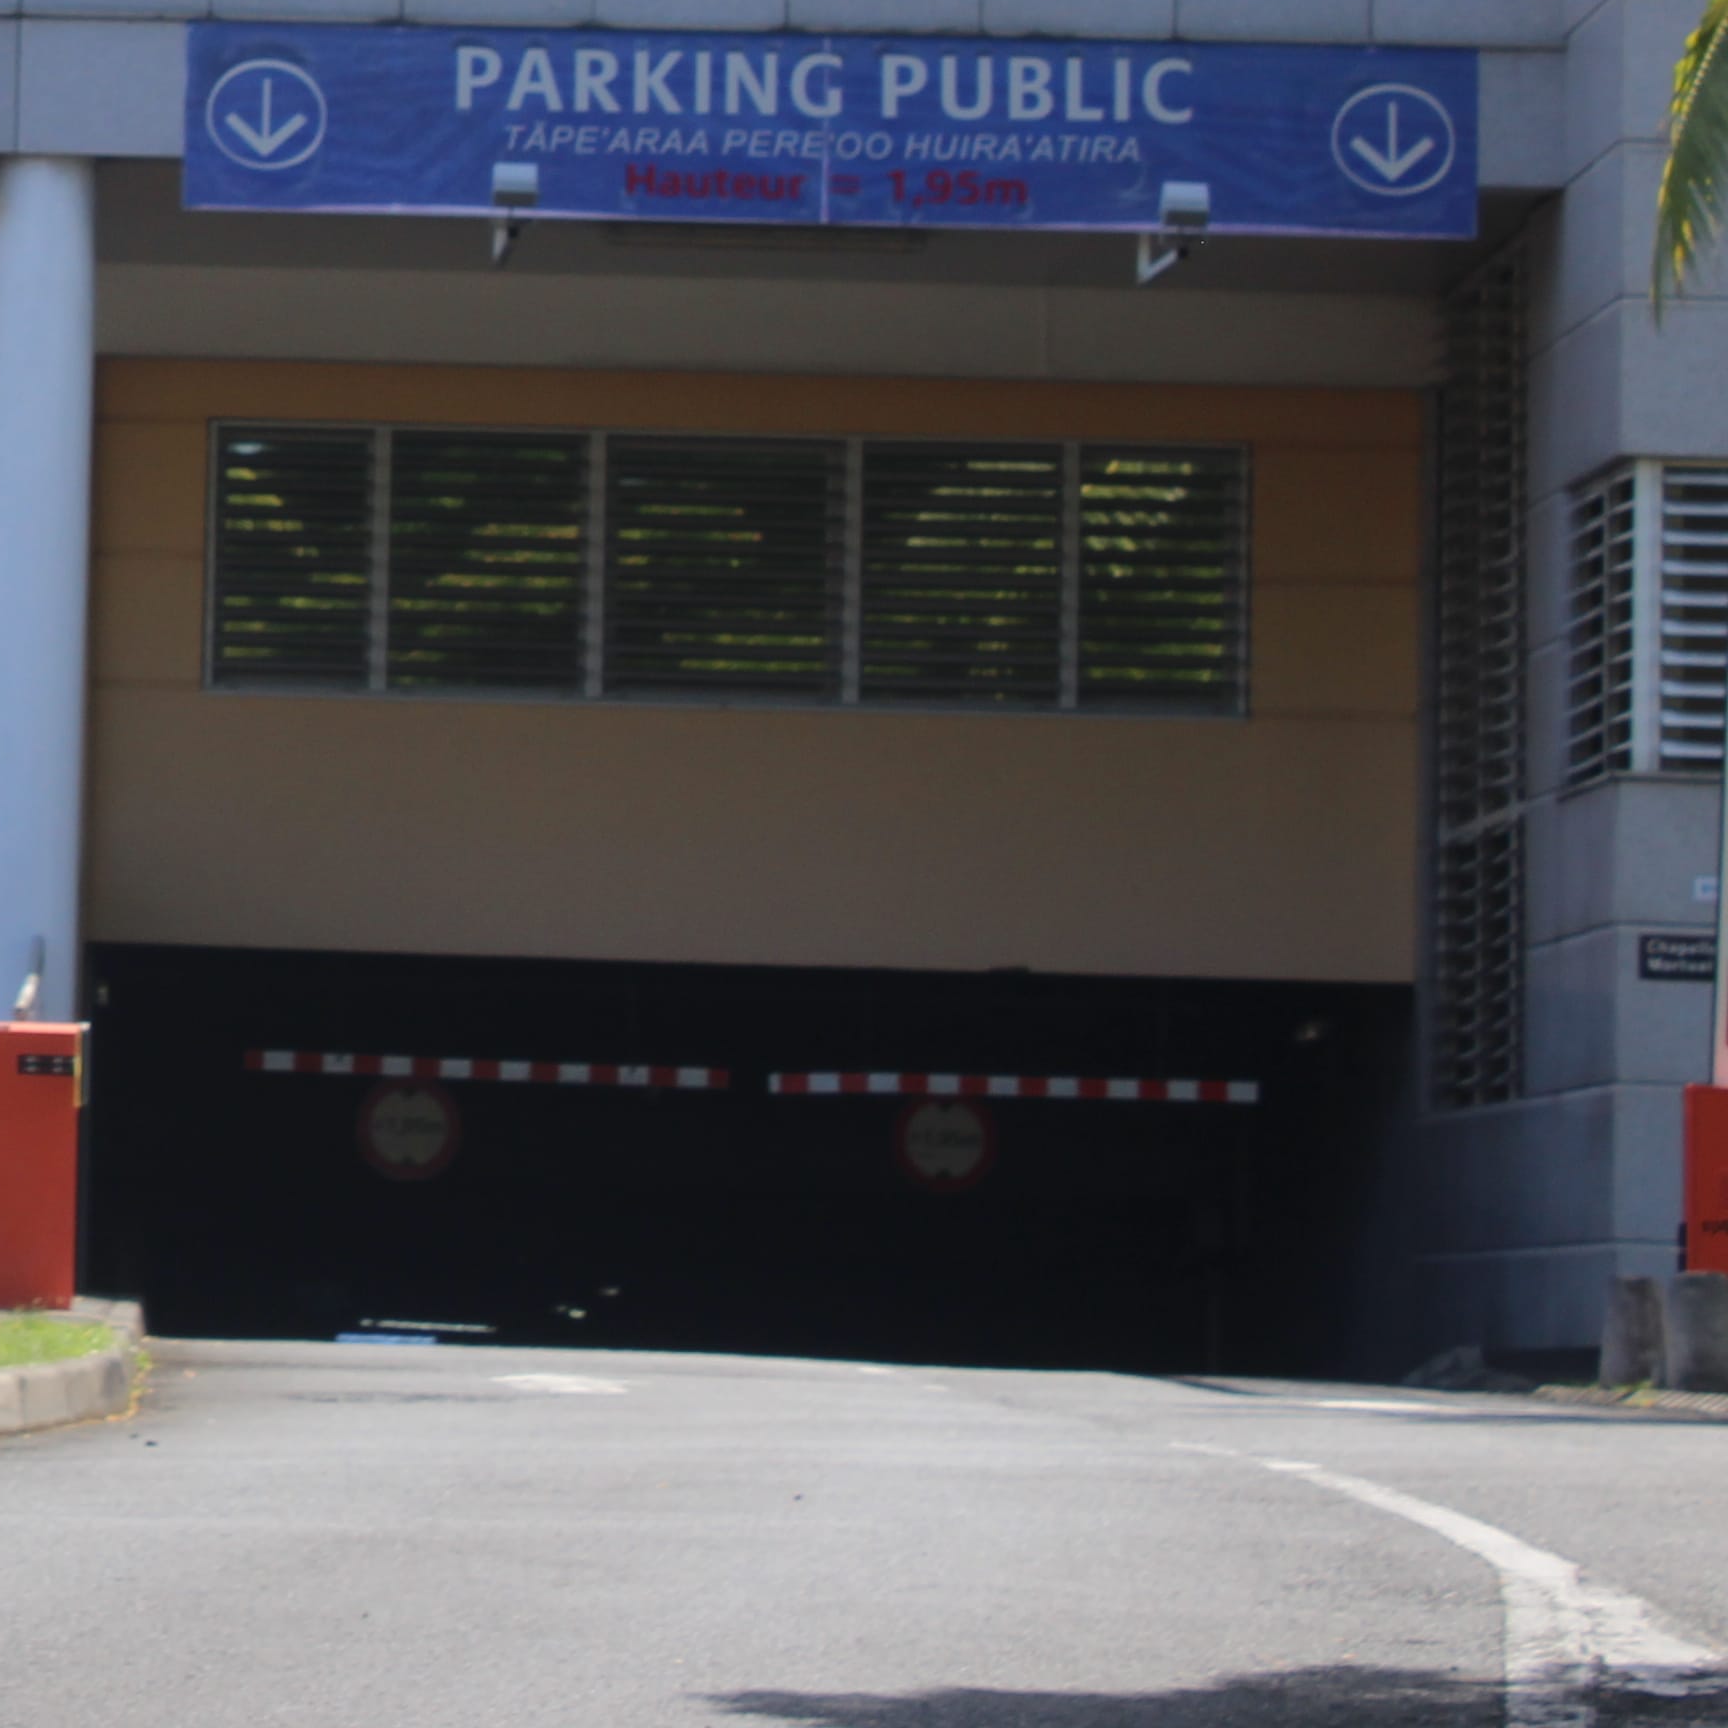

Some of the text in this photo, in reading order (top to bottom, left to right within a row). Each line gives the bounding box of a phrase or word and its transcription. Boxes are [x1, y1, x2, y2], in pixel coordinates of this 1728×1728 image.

[455, 46, 1194, 124] PARKING PUBLIC
[625, 164, 806, 200] Hauteur
[889, 168, 1030, 209] 1,95m
